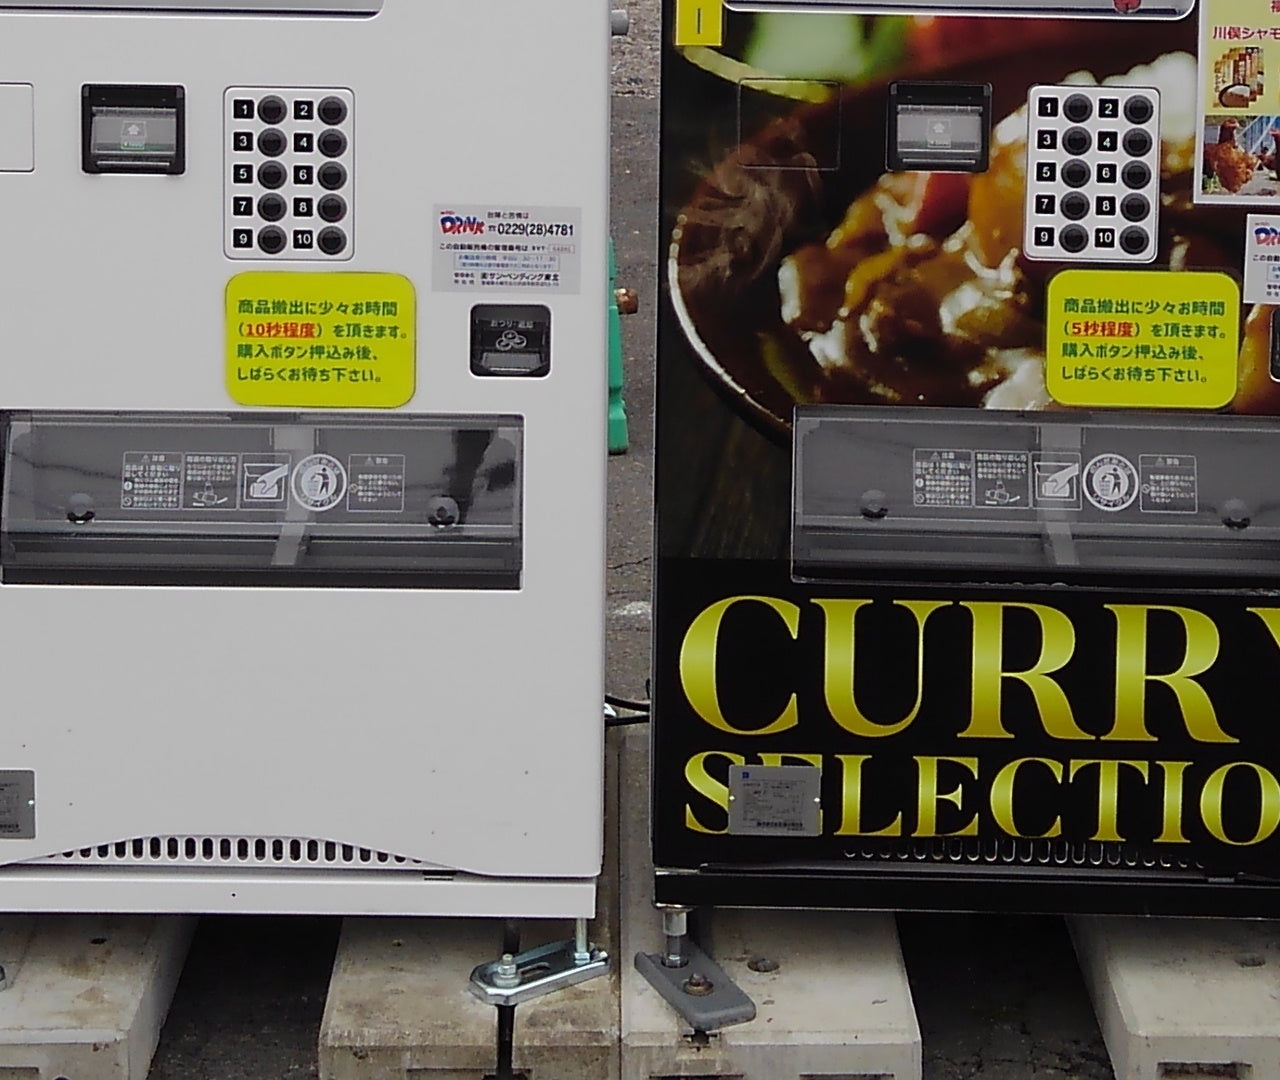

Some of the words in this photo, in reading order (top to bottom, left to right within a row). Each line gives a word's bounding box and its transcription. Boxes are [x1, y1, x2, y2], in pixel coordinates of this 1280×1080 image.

[498, 223, 574, 237] 0229(28)4781
[237, 300, 397, 316] 商品搬出に少々お時間
[1064, 298, 1225, 316] 商品搬出に少々お時間
[237, 367, 381, 383] しばらくお待ち下さい。
[1062, 366, 1207, 383] しばらくお待ち下さい。
